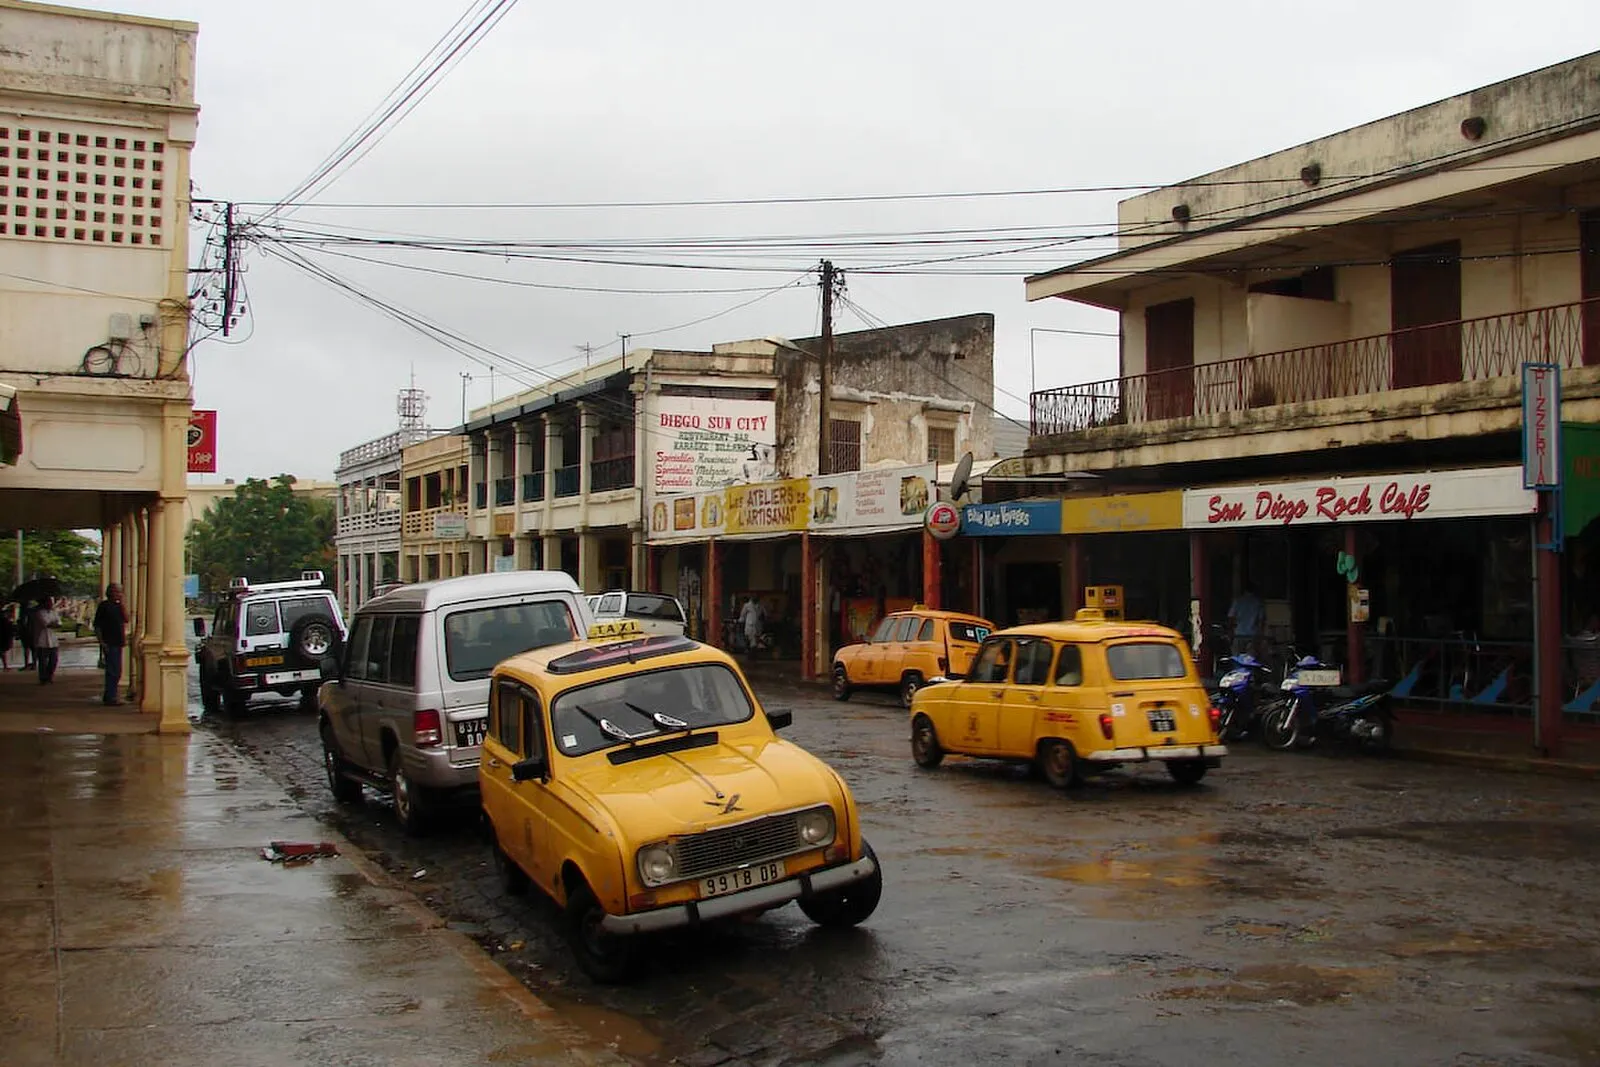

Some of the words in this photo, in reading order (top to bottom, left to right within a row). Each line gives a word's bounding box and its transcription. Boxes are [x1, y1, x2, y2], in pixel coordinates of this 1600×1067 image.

[660, 413, 701, 428] DIEGO
[708, 416, 732, 429] SUN
[737, 416, 767, 430] CITY
[1535, 368, 1546, 485] PIZZERIA
[1208, 495, 1246, 523] San
[1255, 491, 1309, 524] Diego
[1316, 486, 1373, 521] Rock
[1379, 482, 1431, 519] Café
[596, 621, 635, 634] TAXI
[459, 719, 487, 734] 8376
[706, 870, 752, 895] 9918
